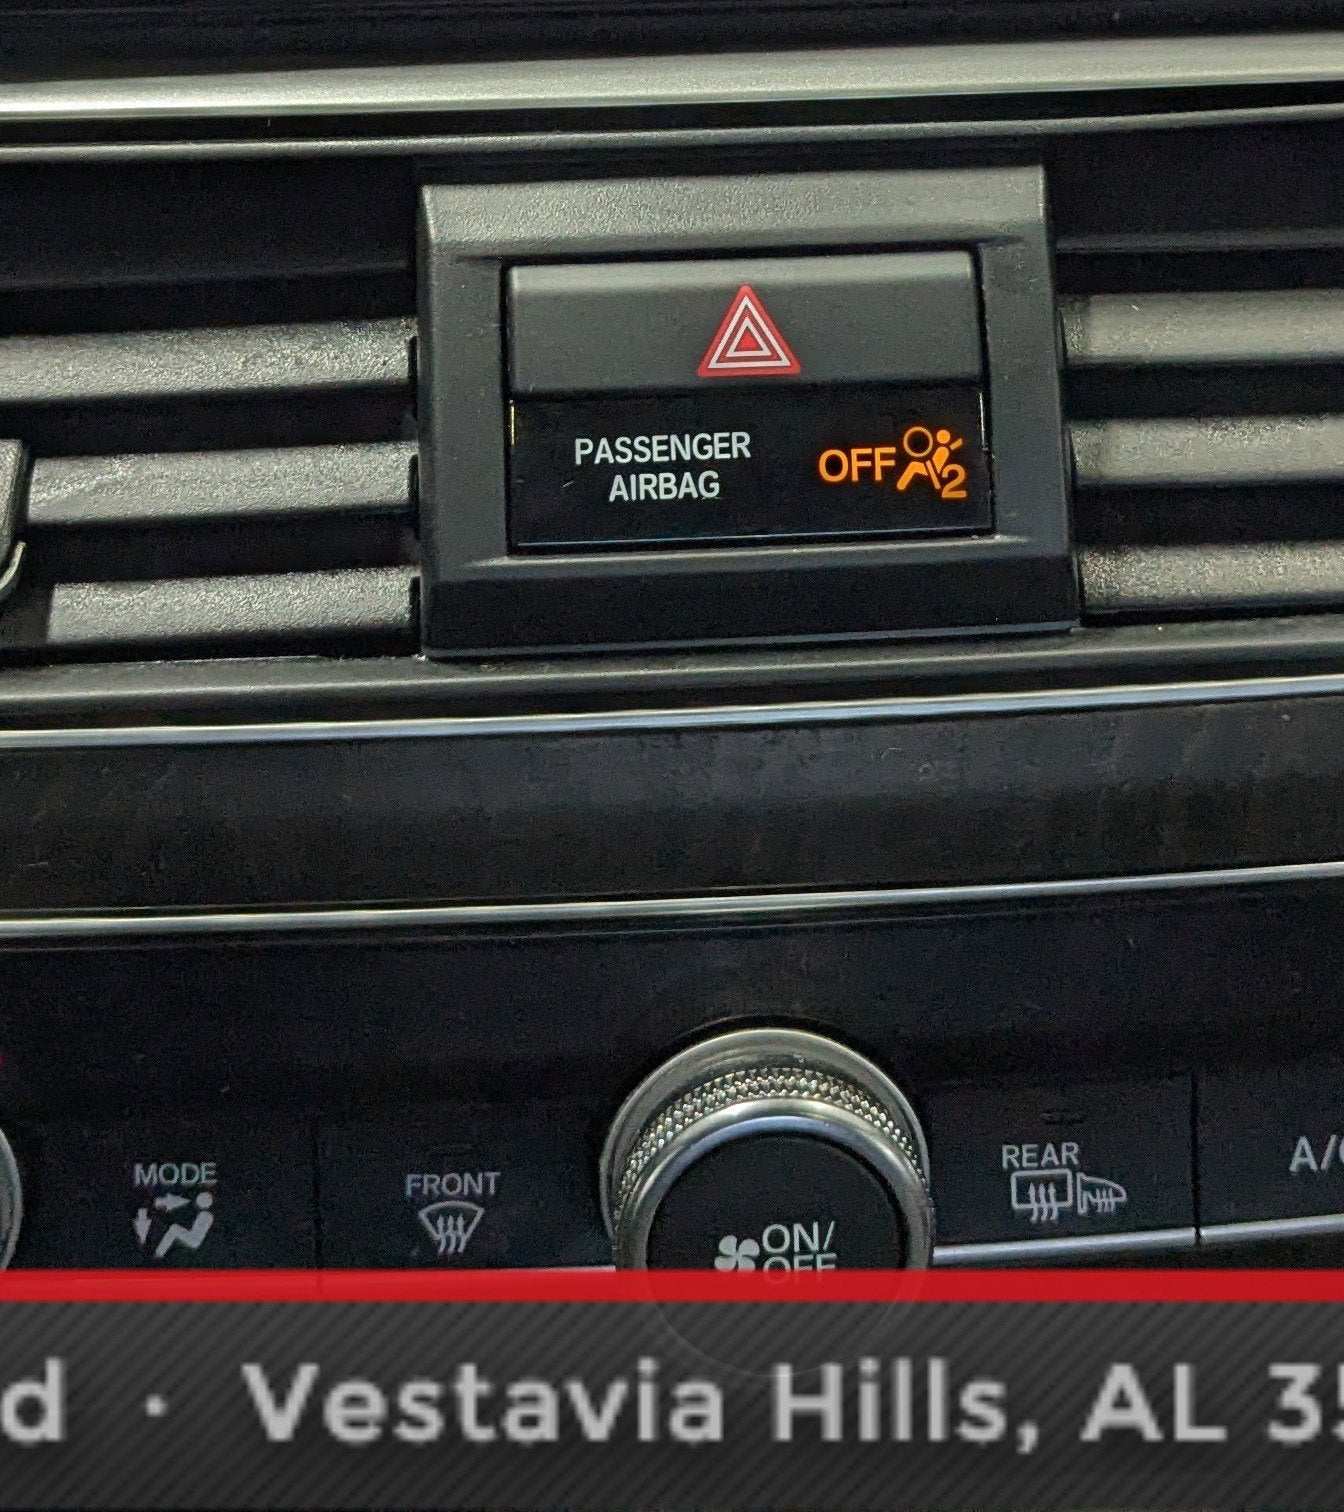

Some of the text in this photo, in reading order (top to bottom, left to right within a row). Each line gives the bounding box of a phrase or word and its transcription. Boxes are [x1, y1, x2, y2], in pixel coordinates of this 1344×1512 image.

[574, 432, 751, 466] PASSENGER
[819, 446, 895, 482] OFF
[609, 470, 720, 503] AIRBAG
[1002, 1143, 1079, 1168] REAR
[134, 1163, 217, 1187] MODE
[405, 1172, 500, 1197] FRONT
[762, 1221, 835, 1253] ON/
